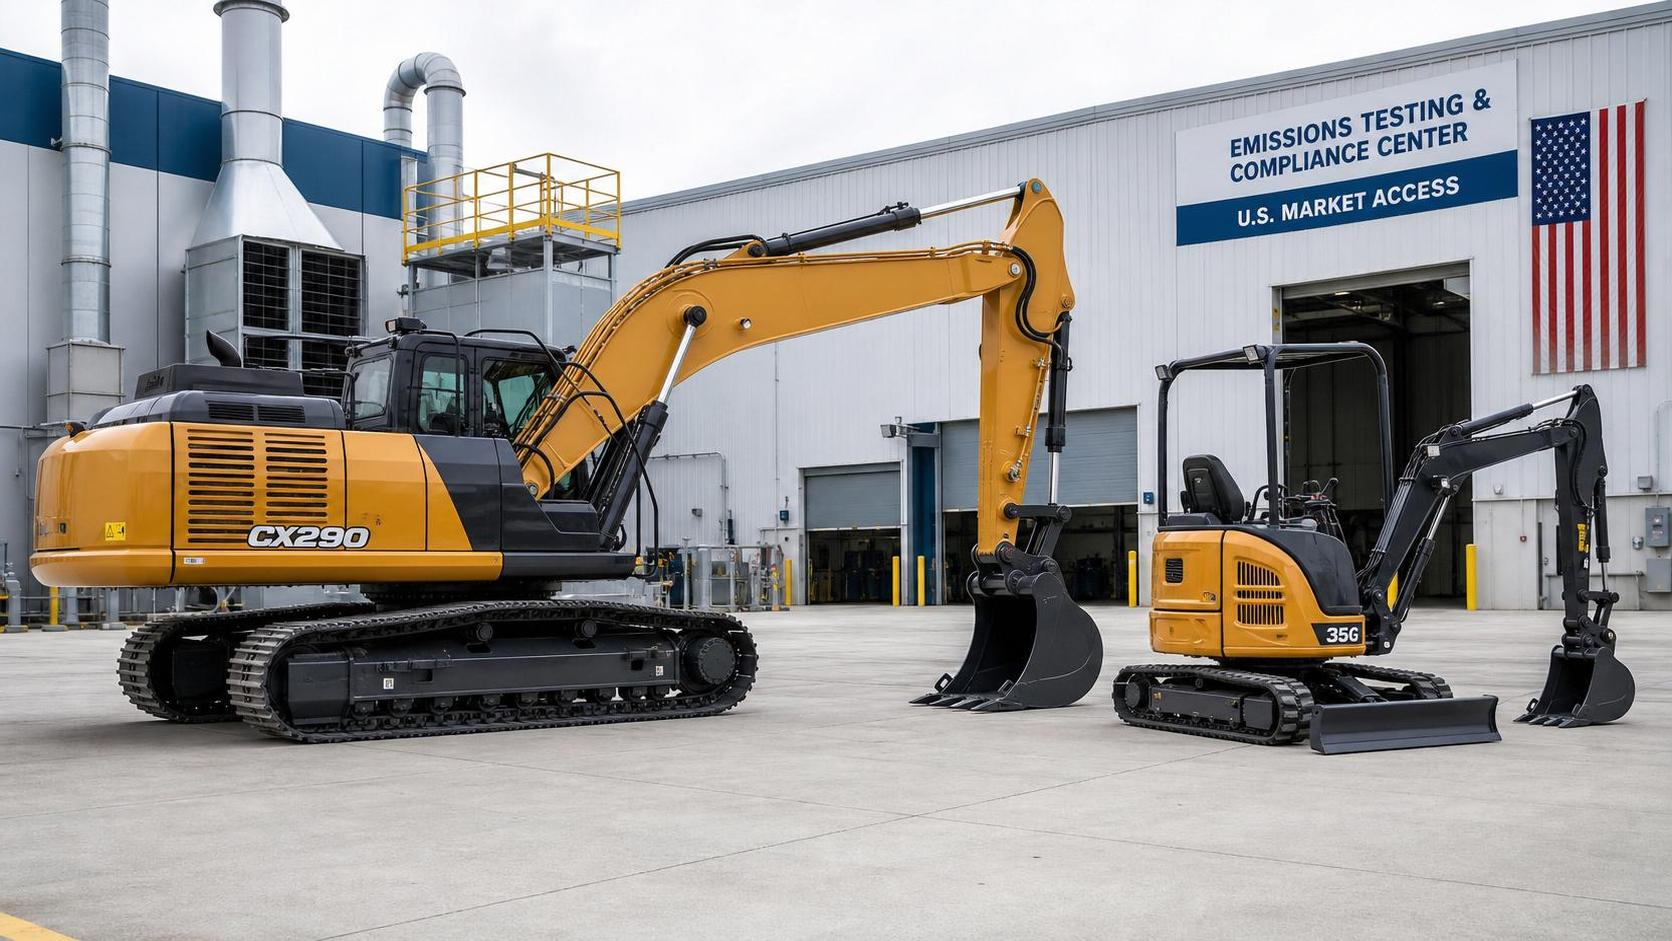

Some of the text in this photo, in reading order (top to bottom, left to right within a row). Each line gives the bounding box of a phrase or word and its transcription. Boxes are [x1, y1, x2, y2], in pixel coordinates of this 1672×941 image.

[1230, 89, 1492, 158] EMISSIONS TESTING &
[1230, 122, 1468, 183] COMPLIANCE CENTER
[1238, 176, 1460, 226] U.S. MARKET ACCESS
[247, 525, 370, 549] CX290
[1326, 626, 1359, 643] 35G
